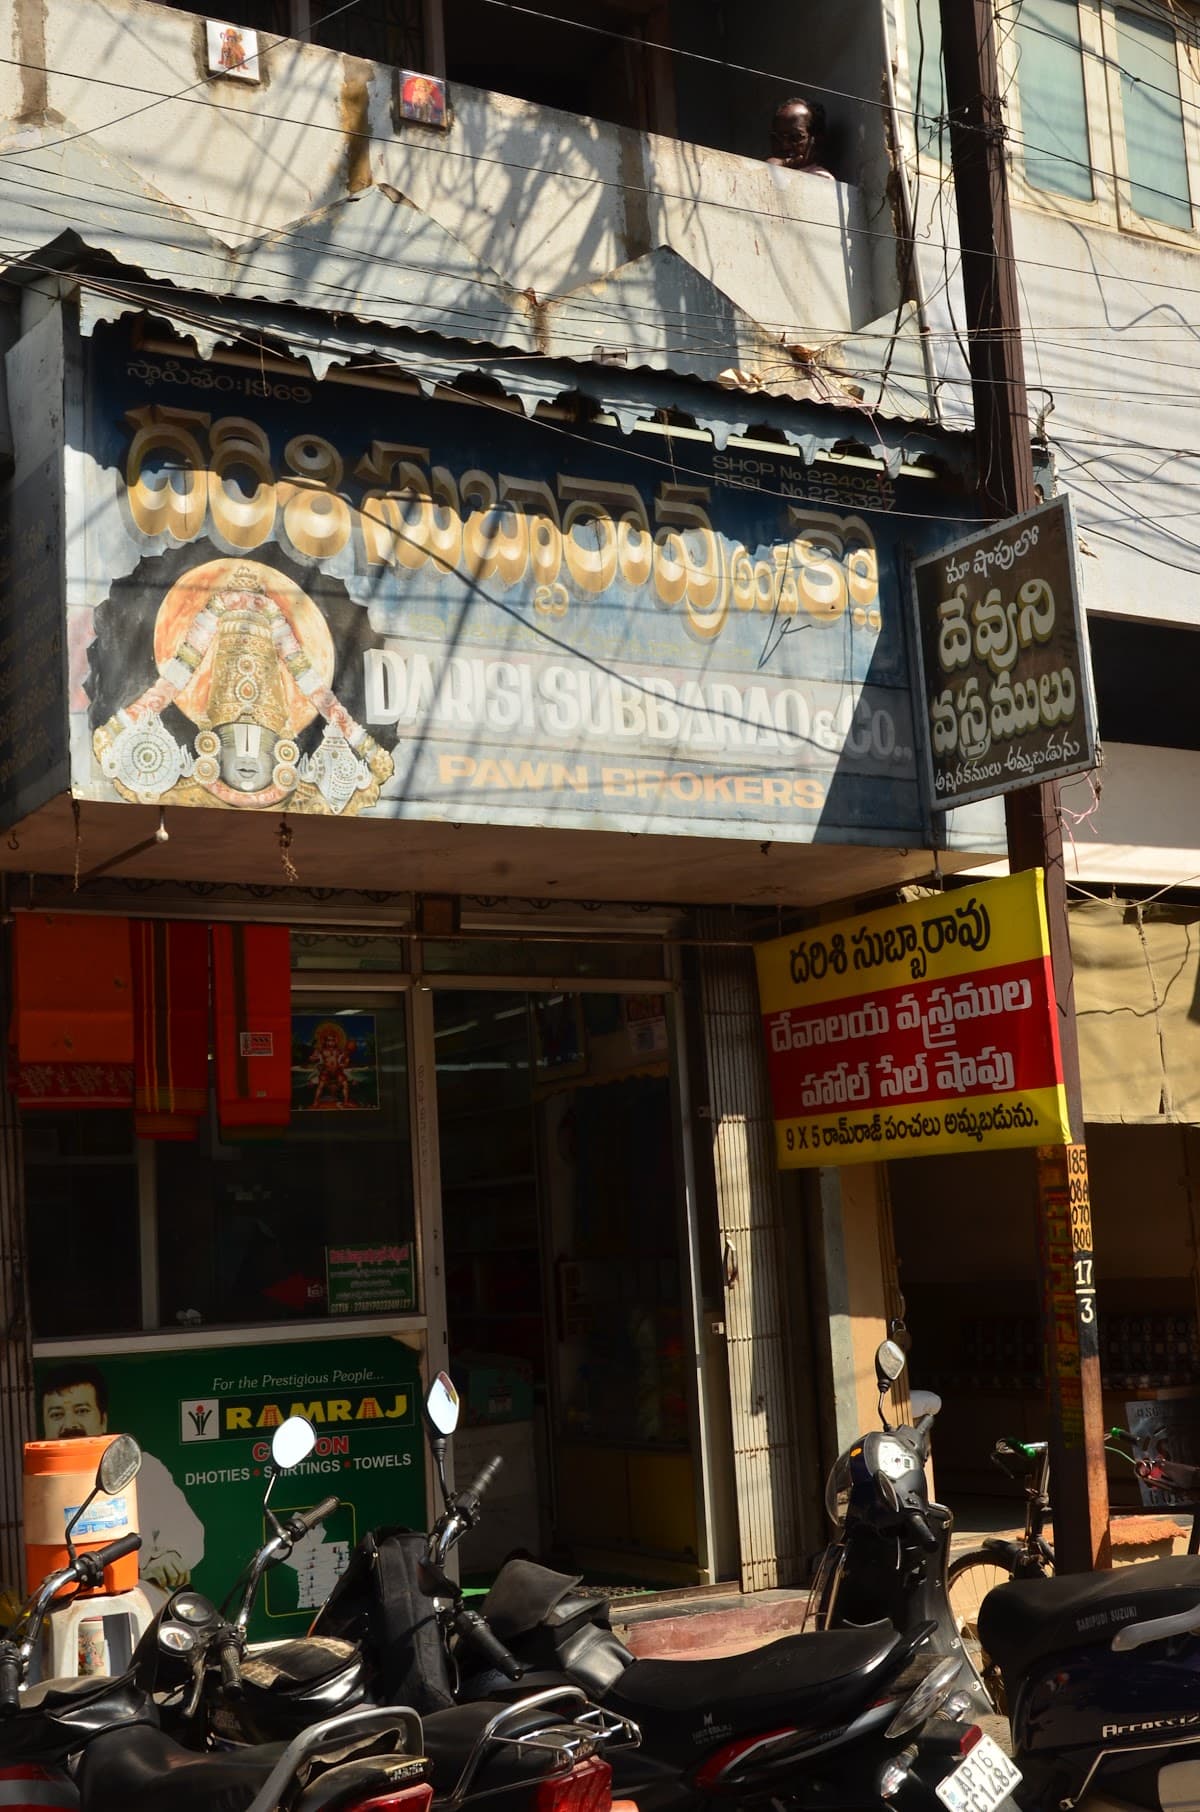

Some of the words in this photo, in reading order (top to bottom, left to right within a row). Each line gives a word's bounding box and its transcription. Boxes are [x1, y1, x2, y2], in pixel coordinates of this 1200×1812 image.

[946, 557, 970, 584] మా
[364, 648, 536, 734] DARISI
[539, 664, 811, 757] SUBBARAO
[931, 667, 1077, 761] వస్త్రములు
[440, 755, 589, 795] PAWN
[602, 768, 827, 810] BROKERS
[790, 931, 849, 985] దరిశి
[852, 898, 991, 980] సుబ్బారావు
[769, 999, 890, 1053] దేవాలయ
[896, 977, 1033, 1050] వస్త్రముల
[801, 1061, 871, 1108] హోల్
[876, 1053, 929, 1098] సేల్
[935, 1046, 1016, 1091] షాపు
[786, 1127, 794, 1151] 9
[812, 1125, 820, 1148] 5
[885, 1112, 941, 1139] పంచలు
[1067, 1148, 1087, 1176] 185
[1074, 1259, 1093, 1286] 17
[1080, 1298, 1094, 1324] 3
[212, 1377, 235, 1392] For
[238, 1375, 258, 1389] the
[262, 1372, 329, 1389] Prestigious
[225, 1394, 408, 1431] RAMRAJ
[252, 1435, 350, 1462] CON
[185, 1467, 250, 1486] DHOTIES
[353, 1452, 412, 1471] TOWELS
